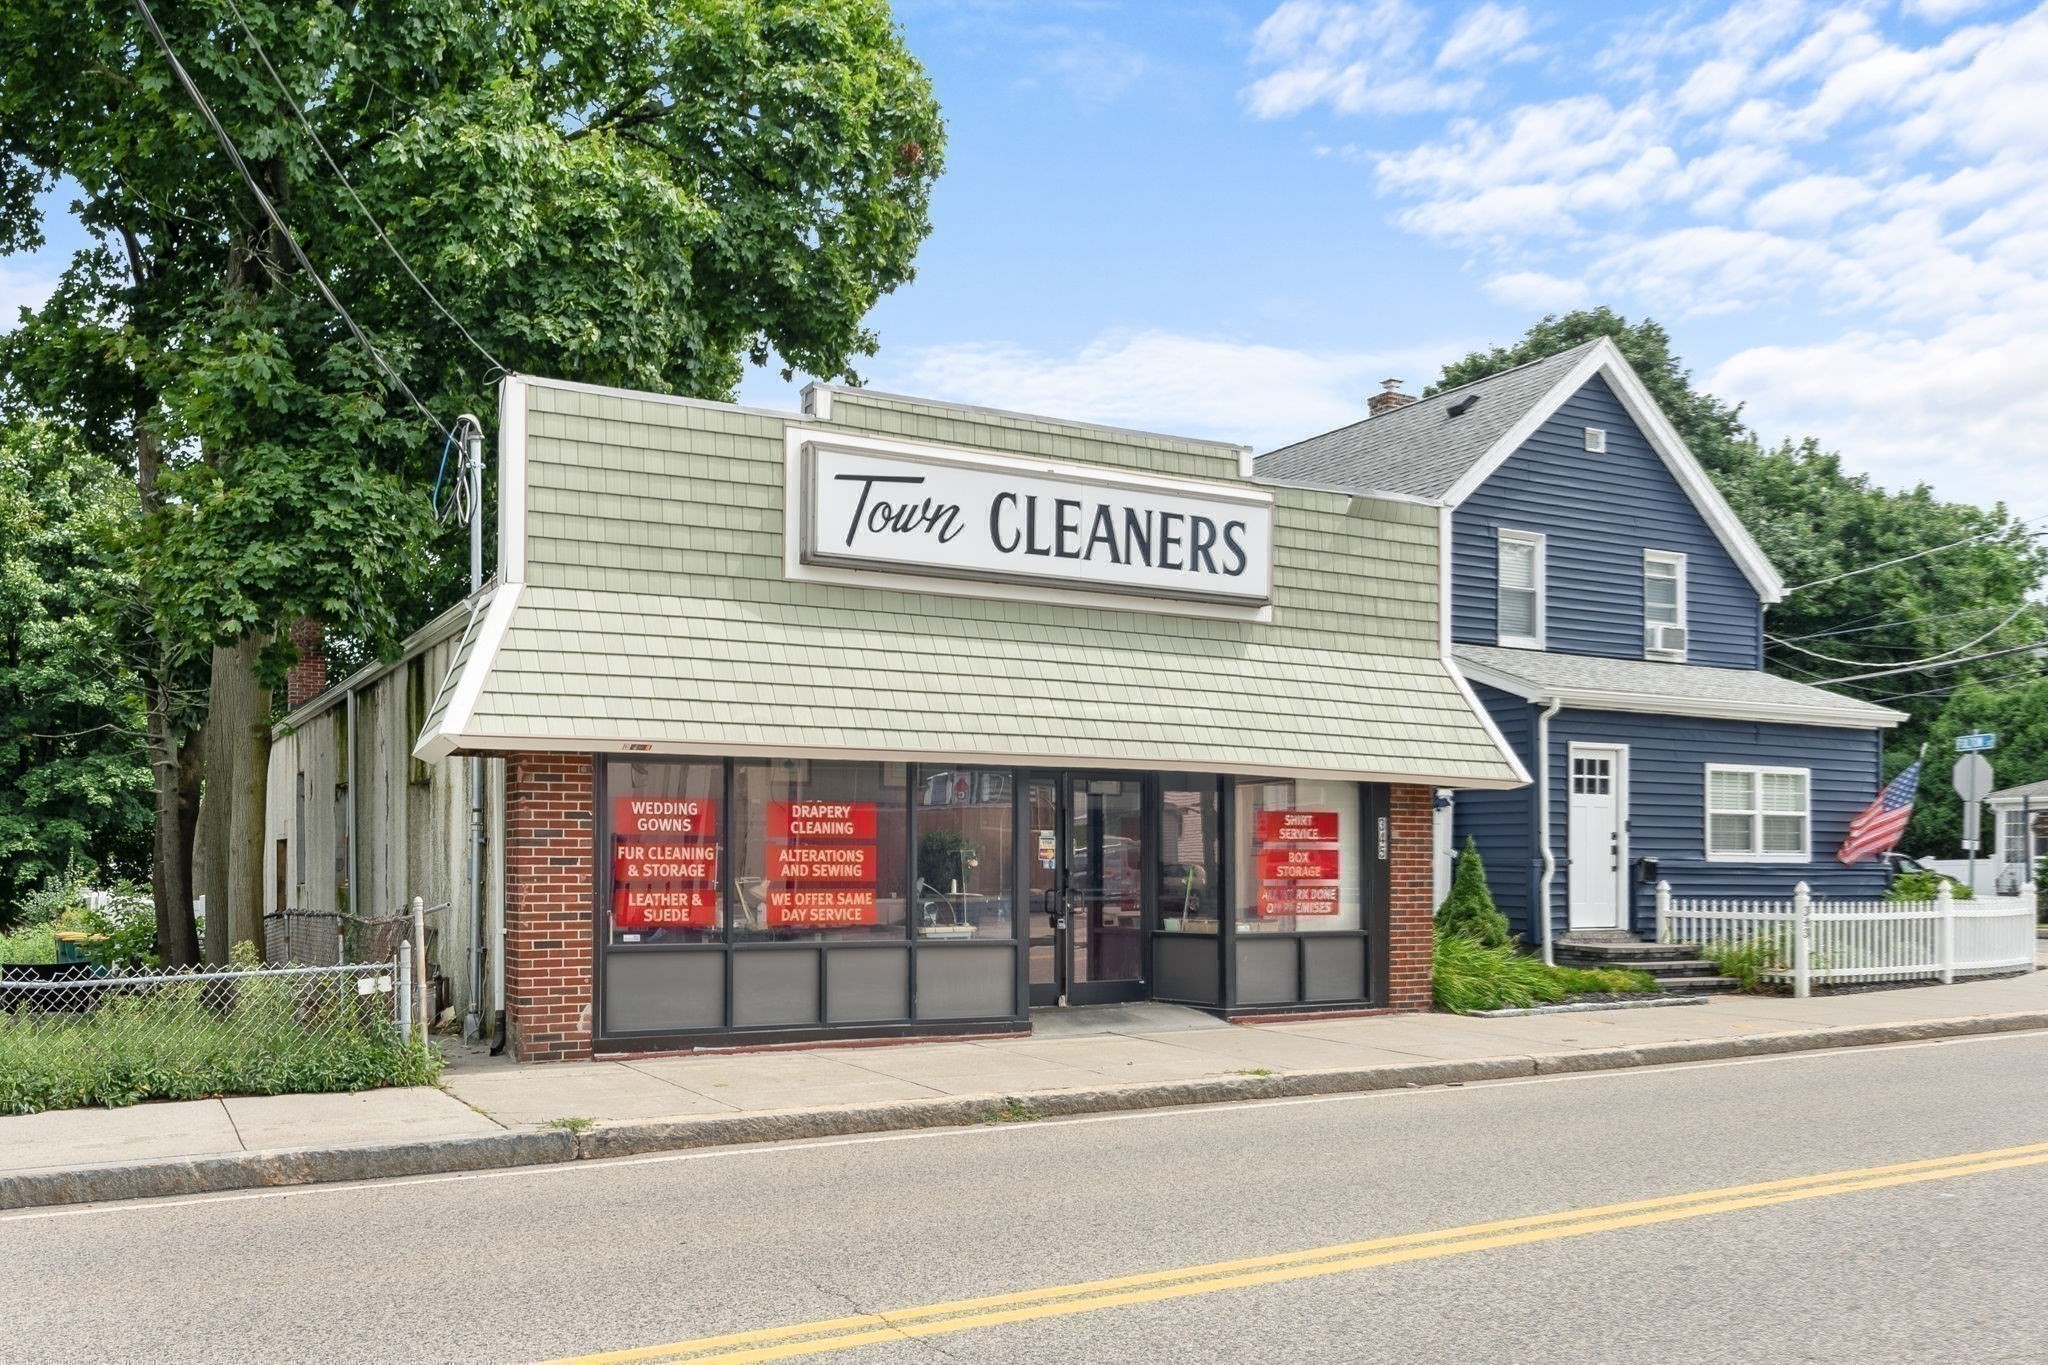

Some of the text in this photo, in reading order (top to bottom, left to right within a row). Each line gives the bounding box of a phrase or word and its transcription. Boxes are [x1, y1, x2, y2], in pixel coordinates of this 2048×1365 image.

[834, 474, 1247, 577] Town CLEANERS
[631, 801, 698, 815] WEDDING
[792, 805, 851, 819] DRAPERY
[637, 818, 692, 832] GOWNS
[1283, 814, 1314, 826] SHIRT
[790, 821, 854, 835] CLEANING
[1278, 828, 1319, 840] SERVICE
[617, 846, 714, 860] FUR CLEANING
[778, 849, 864, 863] ALTERATIONS
[1288, 851, 1309, 863] BOX
[627, 864, 705, 877] & STORAGE
[780, 864, 862, 877] AND SEWING
[1276, 865, 1321, 877] STORAGE
[628, 893, 703, 906] LEATHER &
[770, 892, 872, 906] WE OFFER SAME
[1310, 888, 1337, 900] DONE
[643, 908, 690, 922] SUEDE
[781, 908, 862, 922] DAY SERVICE
